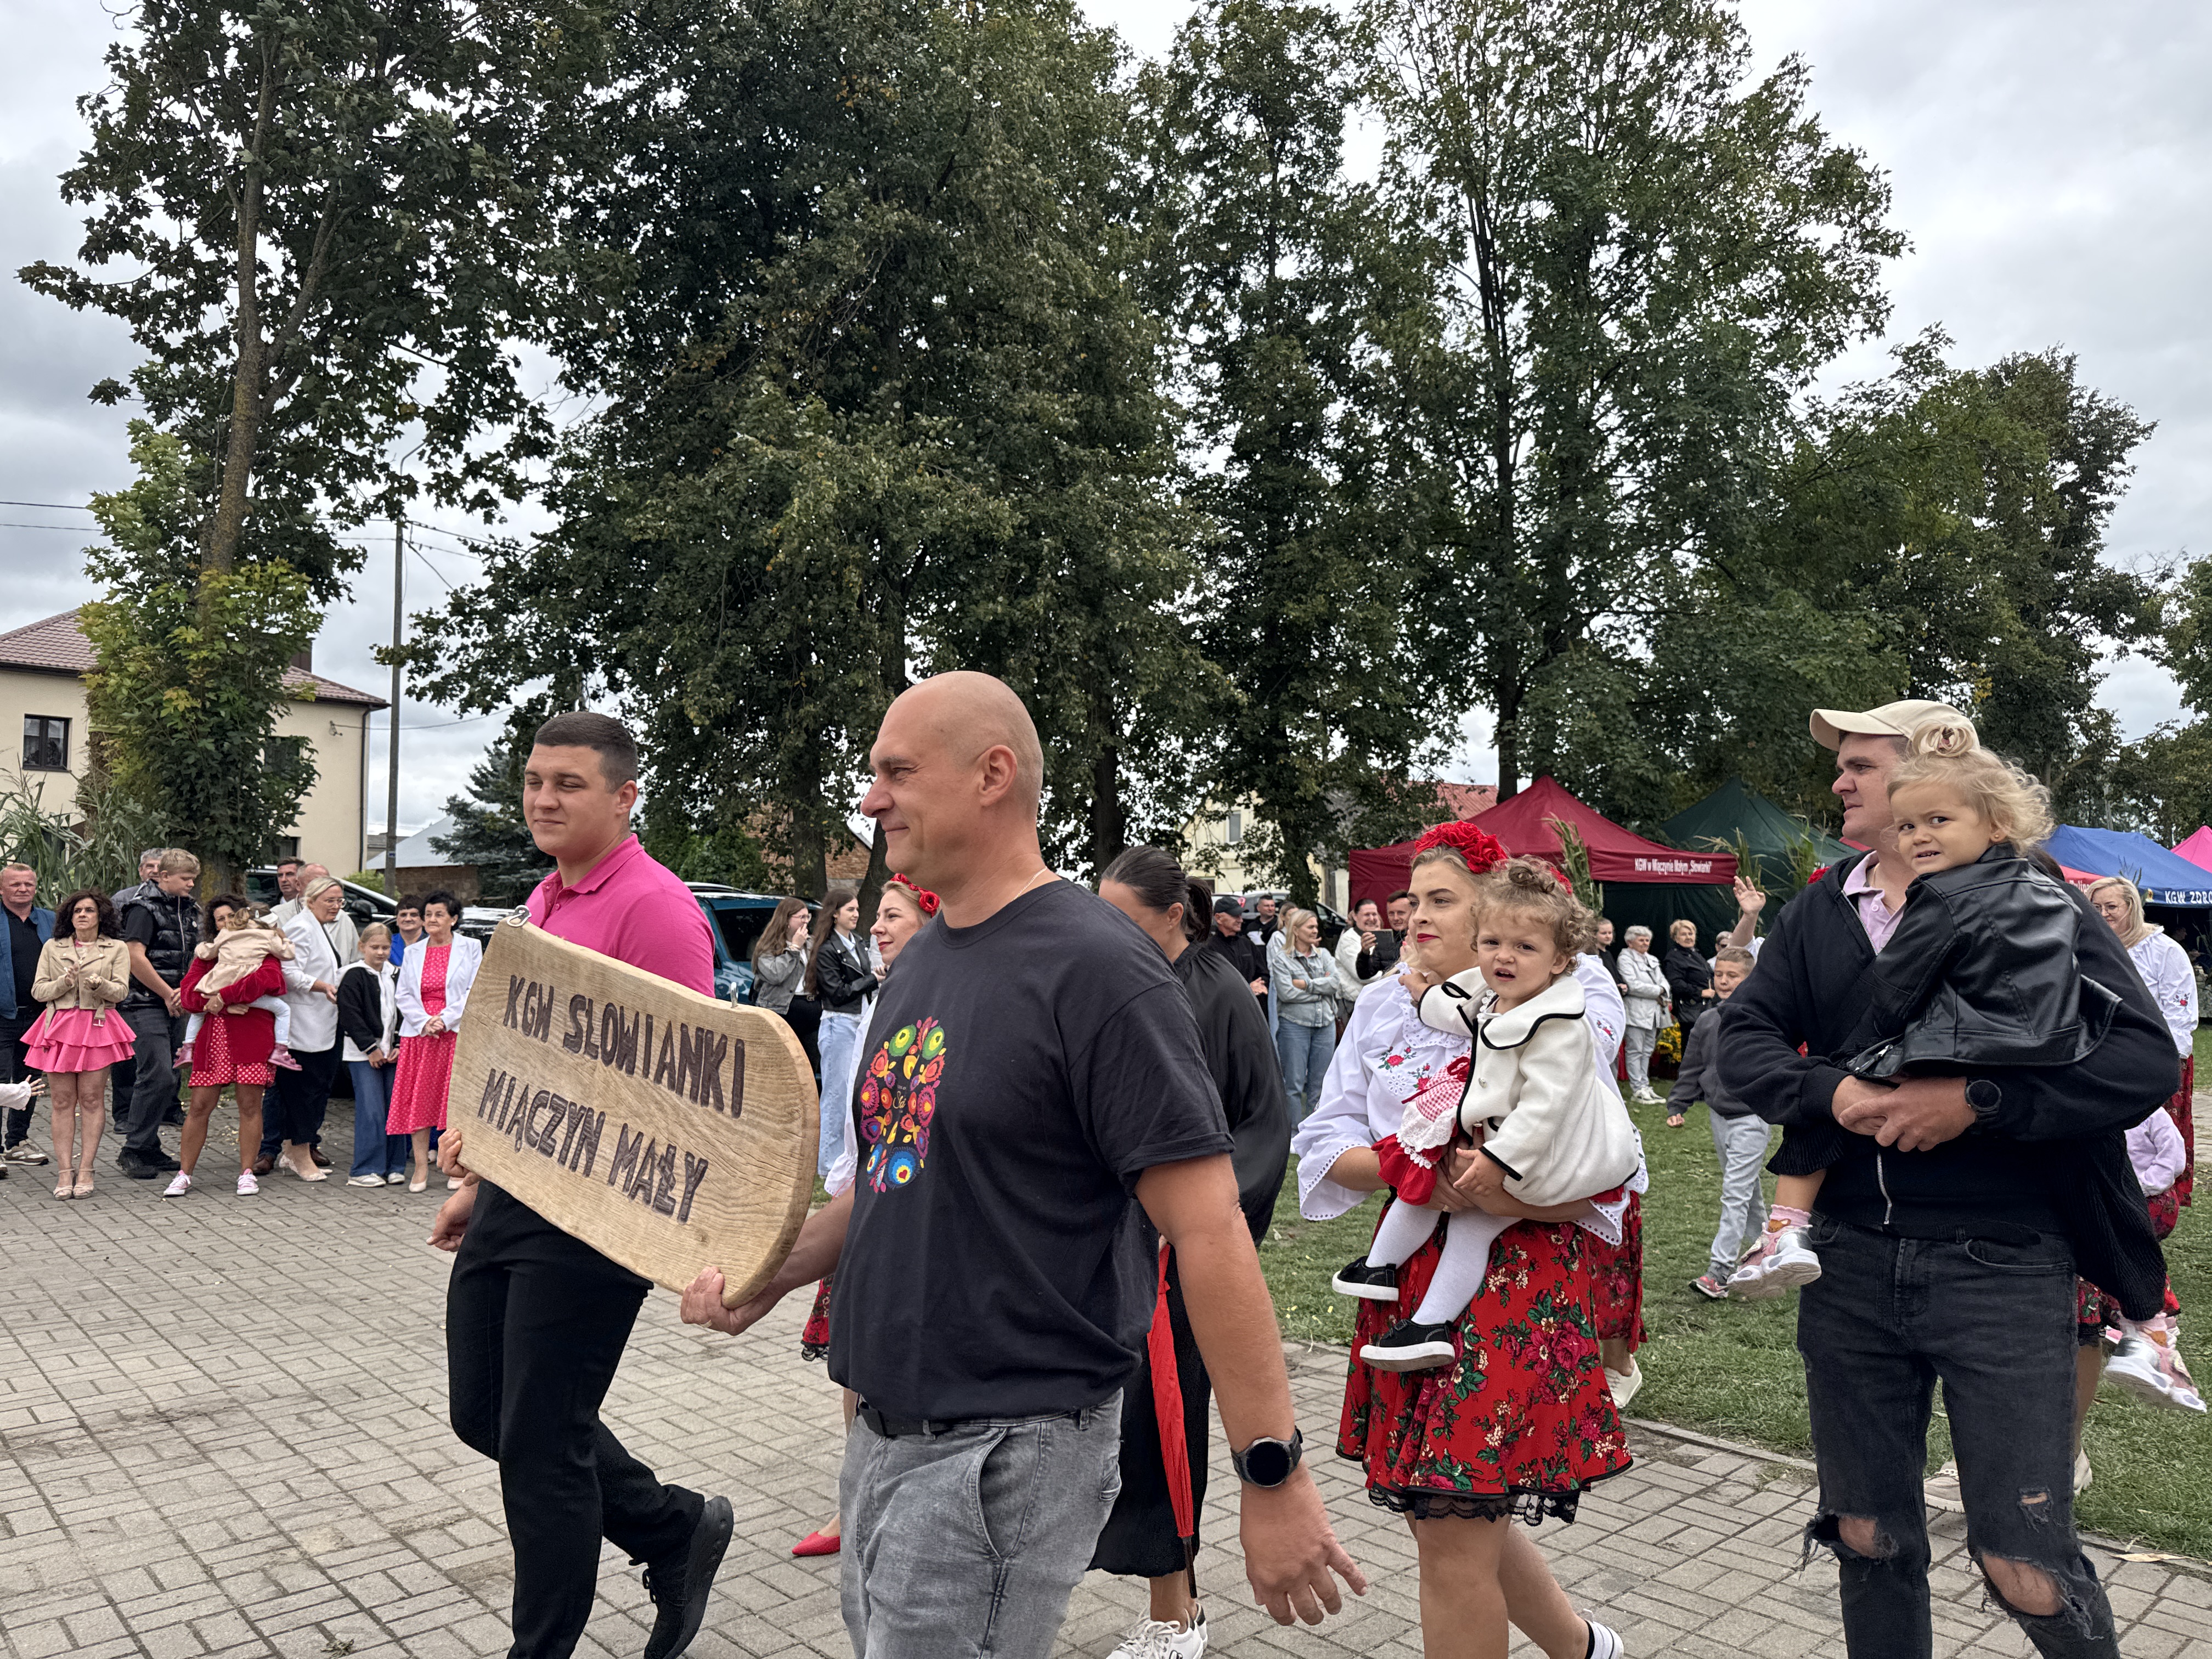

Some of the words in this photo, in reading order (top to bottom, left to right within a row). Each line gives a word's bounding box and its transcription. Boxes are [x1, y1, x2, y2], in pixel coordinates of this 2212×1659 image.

[1635, 858, 1647, 872] KGW
[2165, 891, 2186, 904] KGW
[503, 974, 554, 1043] KGW
[477, 1068, 606, 1178] MIĄCZYN
[608, 1122, 709, 1225] MAŁY
